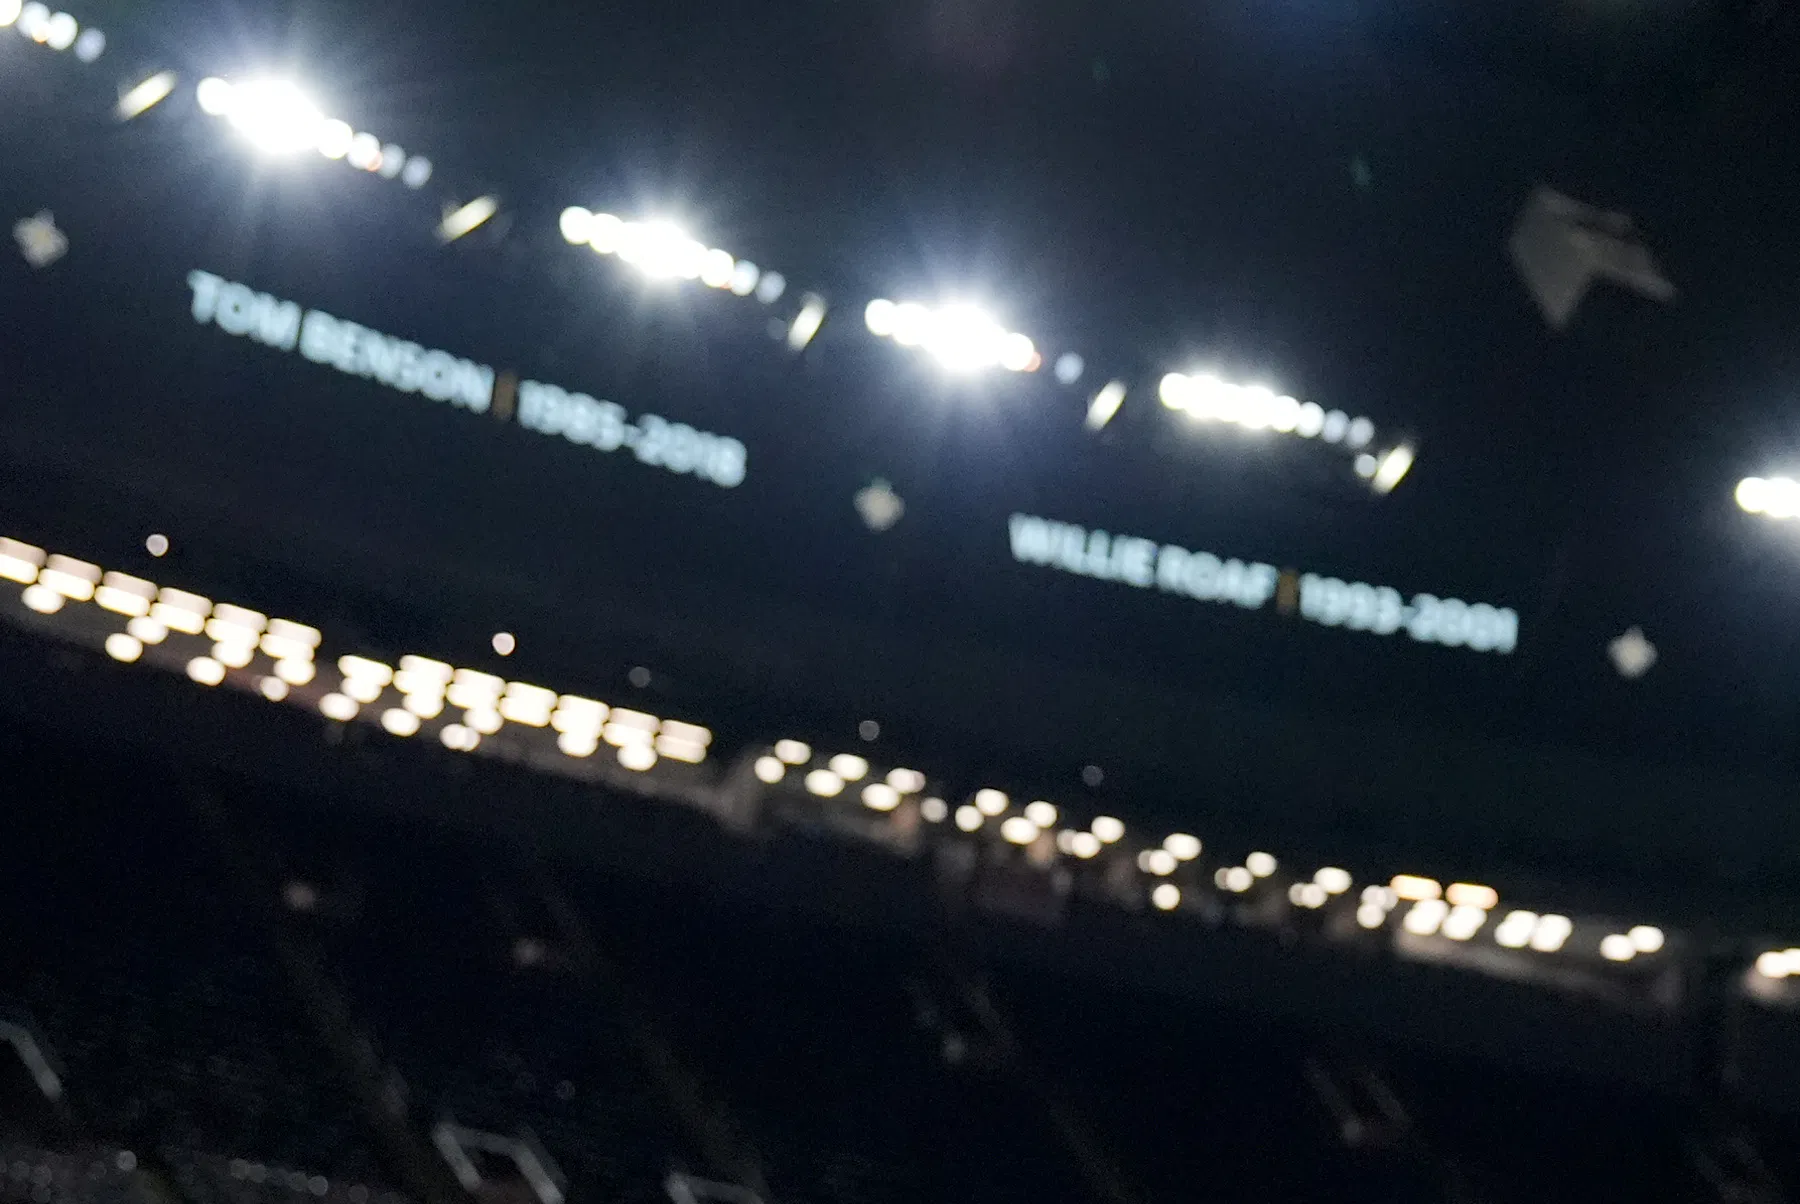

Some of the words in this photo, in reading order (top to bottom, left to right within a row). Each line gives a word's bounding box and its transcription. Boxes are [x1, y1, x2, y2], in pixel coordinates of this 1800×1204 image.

[187, 269, 301, 351] TOM
[301, 309, 495, 414] BENSON
[1008, 513, 1155, 588] WILLIE
[1156, 543, 1278, 609] ROAF
